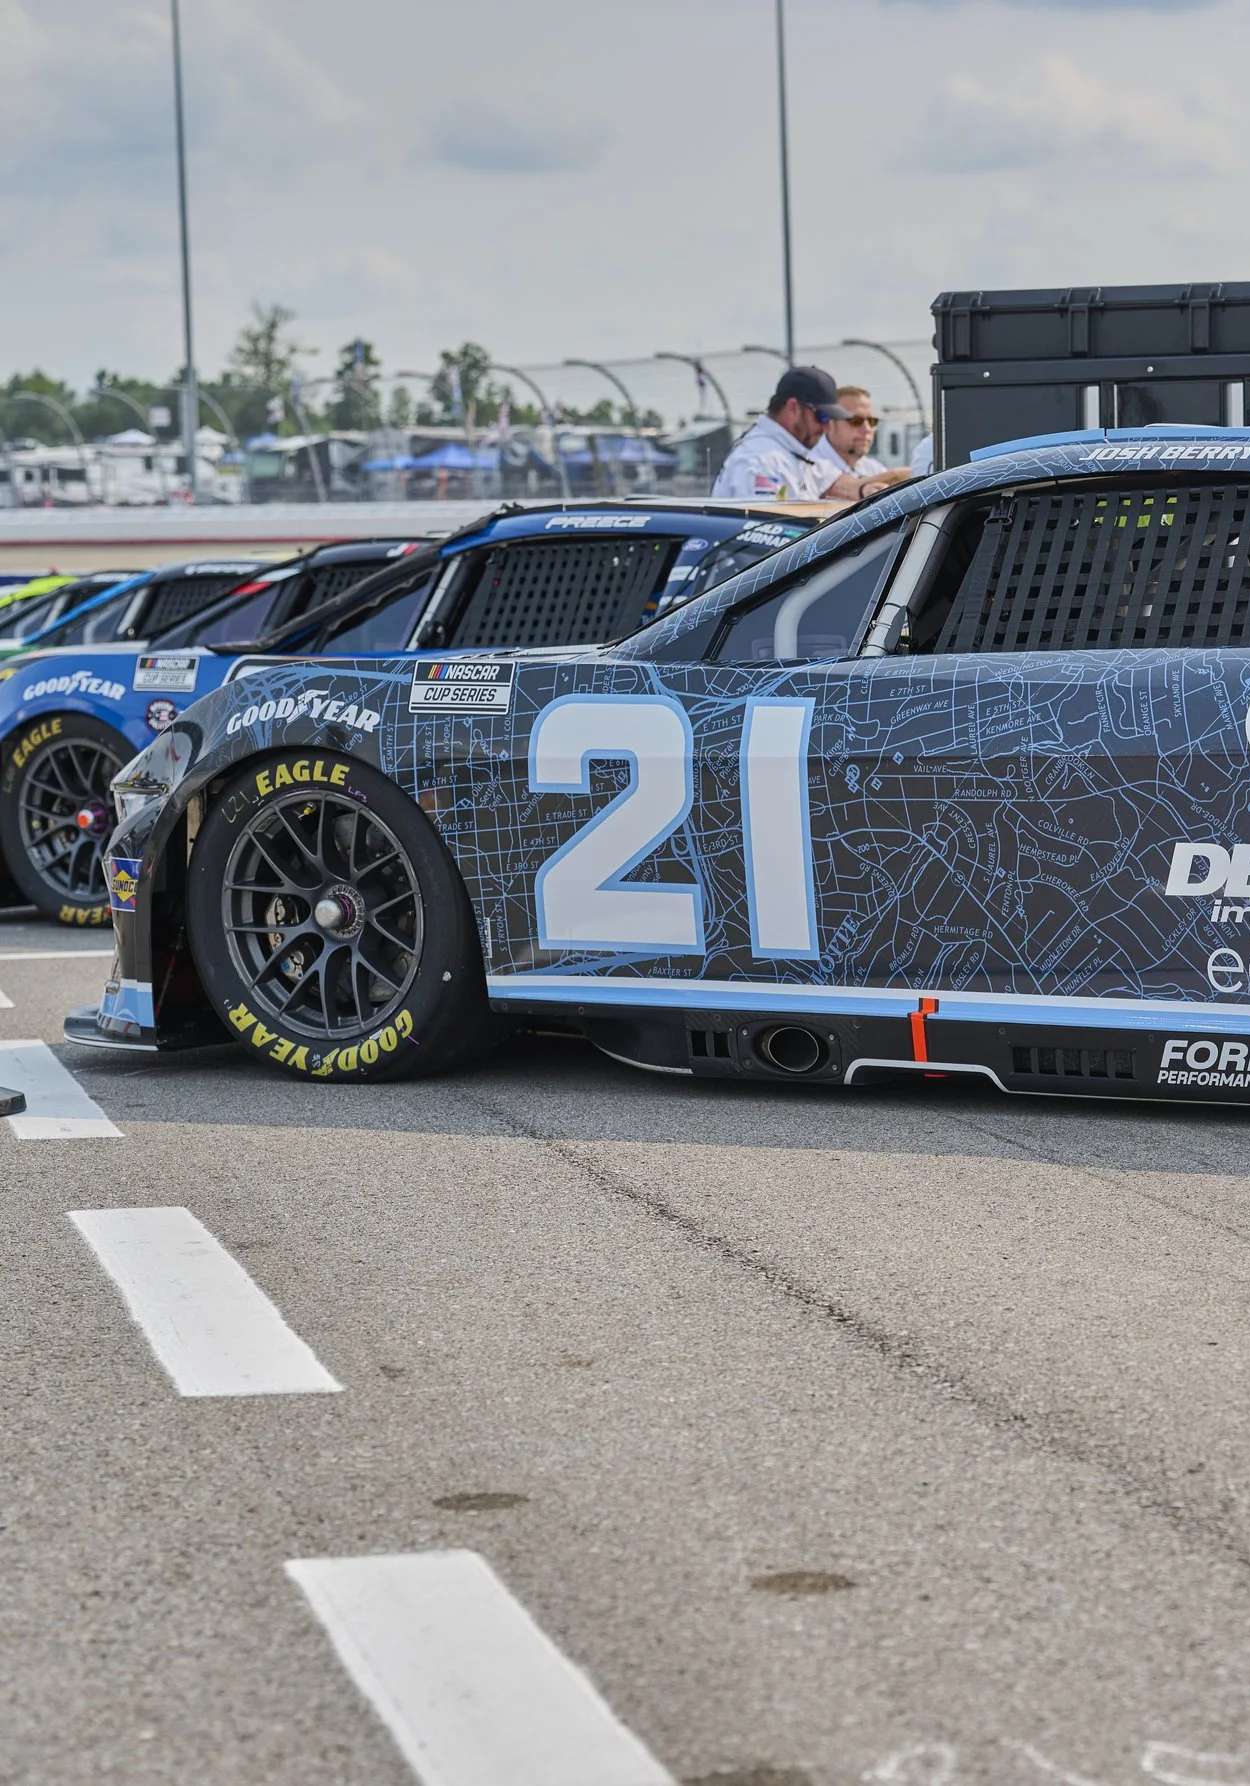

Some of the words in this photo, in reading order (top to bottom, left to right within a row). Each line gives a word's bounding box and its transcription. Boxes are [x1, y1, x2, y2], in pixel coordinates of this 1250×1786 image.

[1079, 446, 1161, 461] JOSH
[544, 515, 653, 529] PREECE
[445, 664, 500, 681] NASCAR
[995, 658, 1053, 677] WEDDINGTON
[1172, 669, 1180, 684] AVE
[424, 687, 451, 702] CUP
[451, 687, 497, 702] SERIES
[897, 687, 913, 696] 7TH
[916, 685, 926, 693] ST
[1139, 690, 1147, 701] ST
[1172, 684, 1183, 718] SKYLAND
[813, 713, 833, 723] PARK
[834, 713, 846, 722] DR
[890, 702, 933, 724] GREENWAY
[934, 699, 949, 710] AVE
[993, 704, 1009, 714] 5TH
[1099, 704, 1112, 734] FANNIE
[1139, 703, 1152, 736] ORANGE
[1217, 698, 1235, 731] MARNEY
[386, 721, 394, 731] ST
[711, 718, 728, 729] 7TH
[985, 720, 1023, 736] KENMORE
[1025, 713, 1042, 725] AVE
[12, 718, 63, 768] EAGLE
[386, 734, 394, 764] SMITH
[424, 738, 432, 759] PINE
[824, 738, 844, 761] Kings
[968, 722, 978, 755] LAUREL
[1021, 736, 1029, 753] AVE
[711, 742, 736, 772] Central
[828, 748, 852, 777] College
[255, 760, 350, 798] EAGLE
[913, 765, 930, 773] VAIL
[932, 765, 947, 774] AVE
[1020, 755, 1034, 794] DOTGER
[1045, 755, 1085, 786] CRANBROOK
[431, 777, 447, 786] 6TH
[471, 781, 484, 798] Old
[478, 773, 502, 807] Settlers
[488, 792, 503, 812] Cem
[954, 788, 998, 798] RANDOLPH
[1001, 789, 1012, 798] RD
[552, 811, 577, 820] TRADE
[578, 809, 588, 818] ST
[1202, 810, 1227, 832] RIDGE
[438, 822, 462, 832] TRADE
[464, 821, 474, 830] ST
[528, 693, 820, 960] 21
[948, 811, 976, 850] CRESCENT
[985, 822, 996, 839] AVE
[1037, 819, 1077, 842] COLVILLE
[1077, 834, 1090, 846] RD
[710, 838, 727, 850] 3RD
[1019, 843, 1068, 863] HEMPSTEAD
[1069, 854, 1080, 863] PL
[985, 841, 997, 877] LAUREL
[1089, 850, 1124, 883] EASTOVER
[1120, 837, 1131, 851] RD
[870, 868, 896, 897] QUEENS
[953, 872, 964, 884] 16
[1001, 884, 1014, 918] FENTON
[1040, 873, 1081, 900] CHEROKEE
[1078, 900, 1090, 912] RD
[497, 916, 506, 945] TRYON
[933, 925, 980, 937] HERMITAGE
[982, 928, 994, 939] RD
[1161, 918, 1188, 952] LOCKLEY
[1186, 907, 1197, 920] DR
[888, 937, 915, 972] BROMLEY
[910, 926, 920, 939] RD
[969, 952, 980, 965] RD
[1040, 935, 1075, 973] MIDDLETON
[1070, 925, 1082, 940] DR
[652, 966, 681, 977] BAXTER
[683, 968, 692, 977] ST
[1065, 965, 1095, 994] HUNTLEY
[1093, 956, 1104, 969] PL
